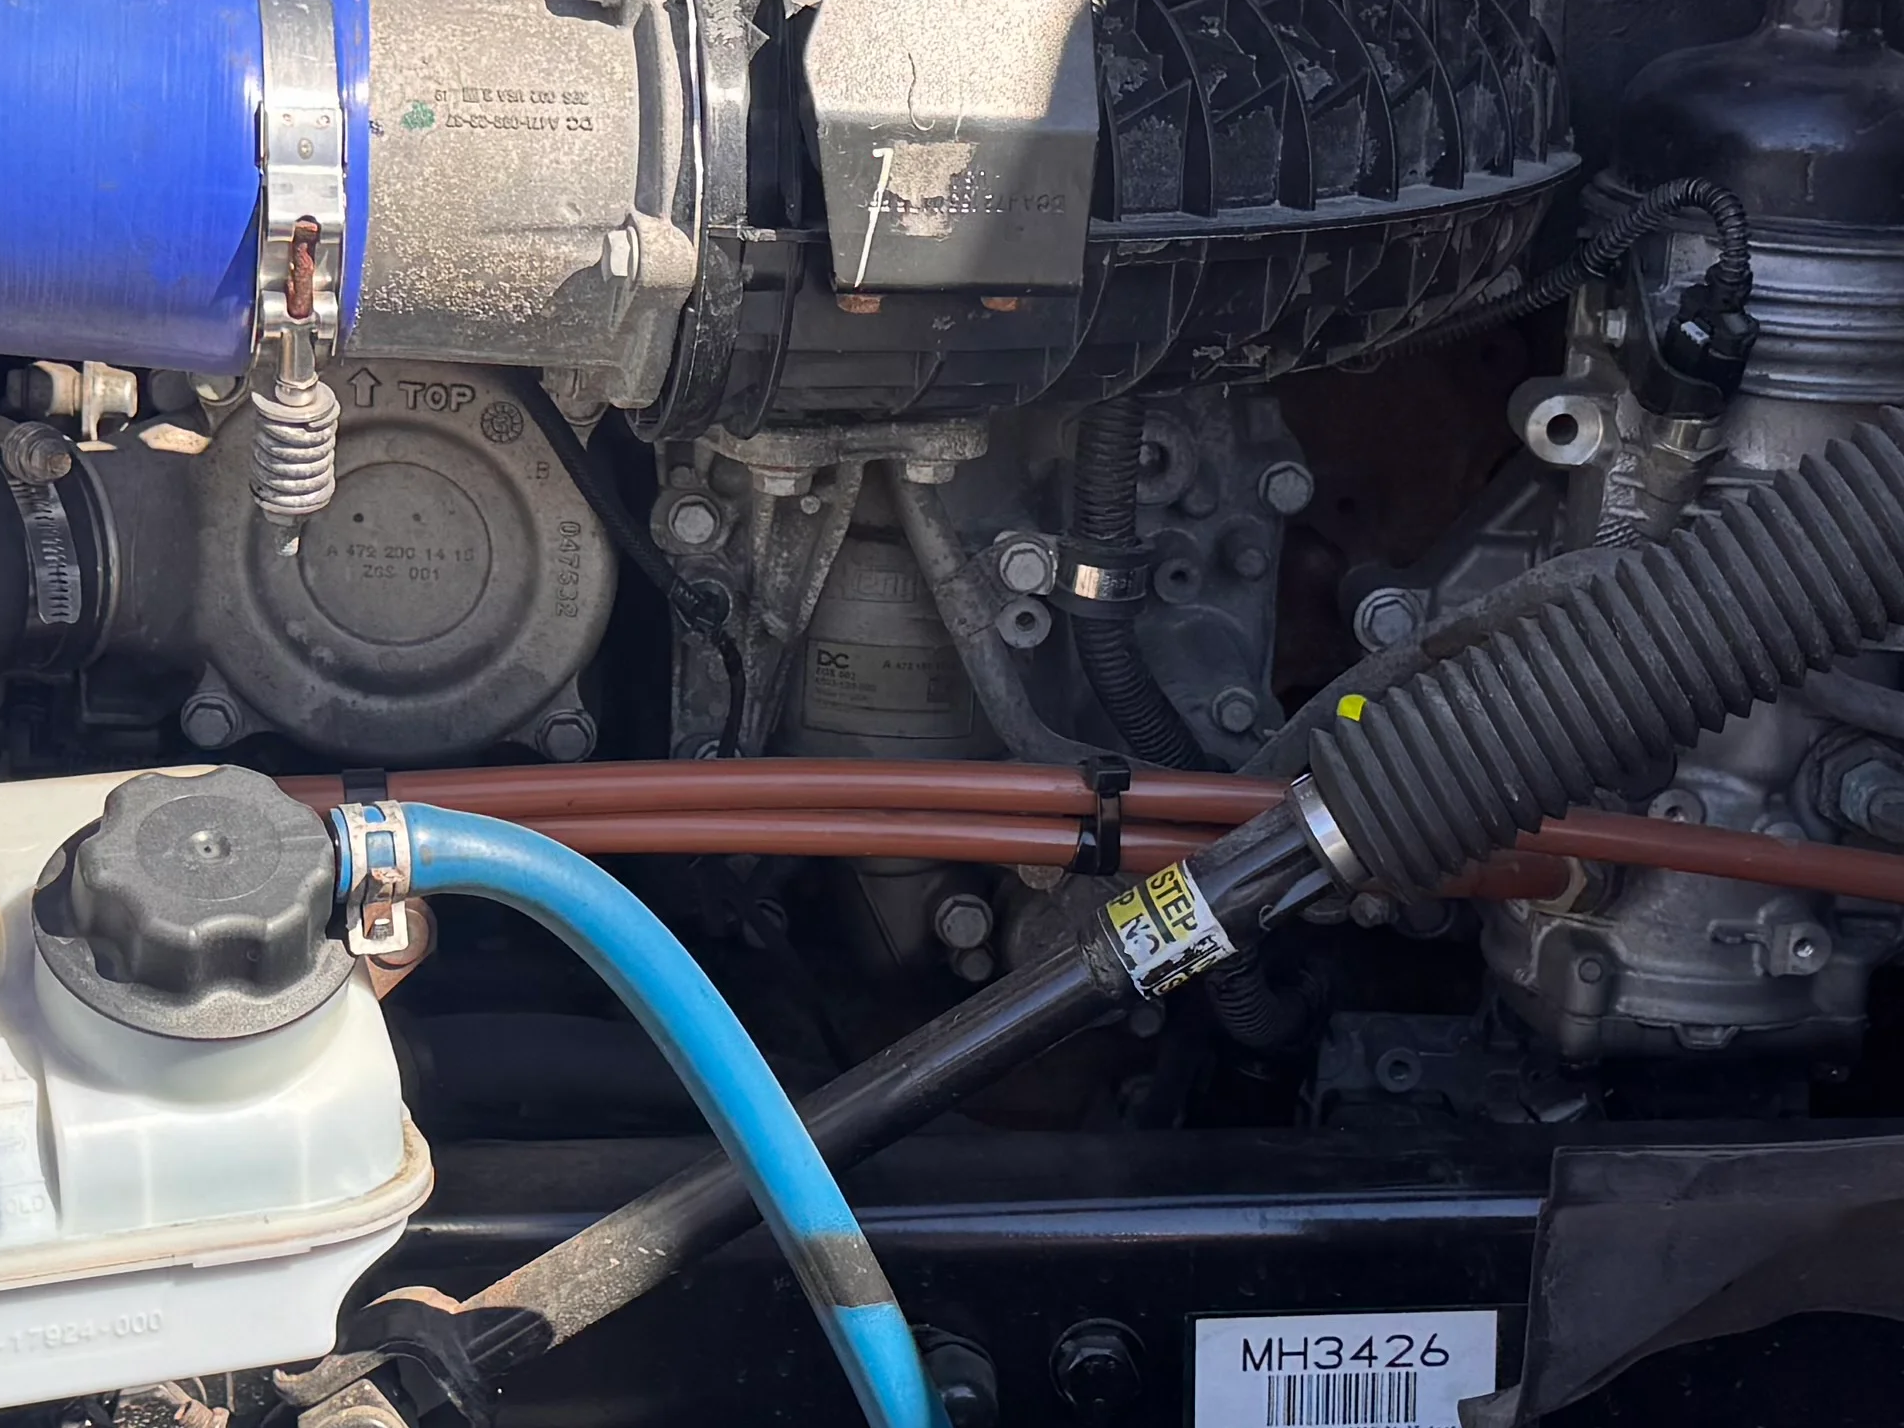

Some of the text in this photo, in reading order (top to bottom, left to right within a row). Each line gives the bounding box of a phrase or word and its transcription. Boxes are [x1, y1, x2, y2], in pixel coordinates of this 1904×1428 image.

[398, 380, 476, 412] TOP
[346, 545, 377, 559] 472
[818, 649, 849, 669] DC
[1151, 870, 1198, 931] STEP
[1242, 1333, 1449, 1372] MH3426
